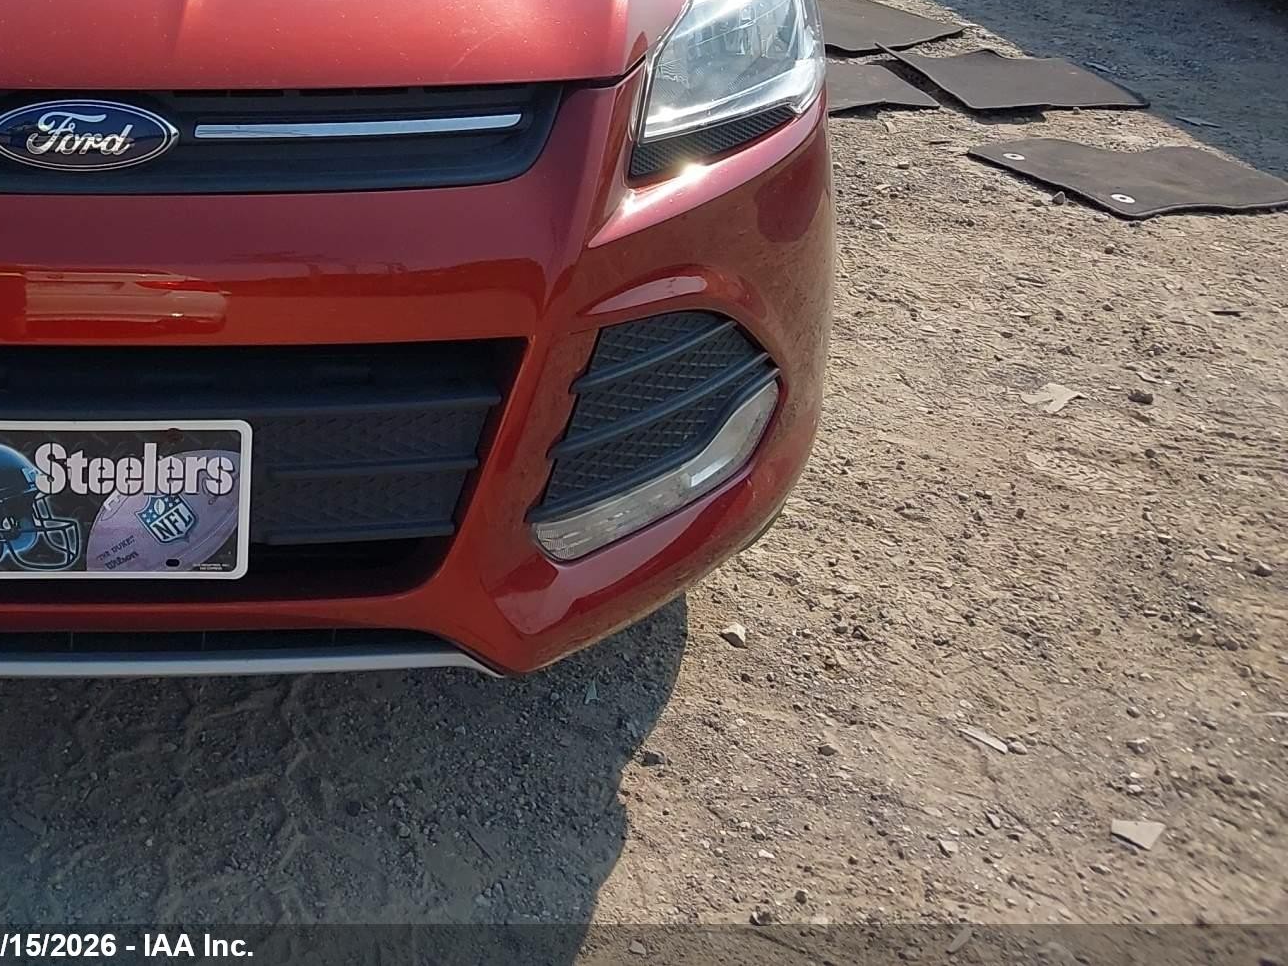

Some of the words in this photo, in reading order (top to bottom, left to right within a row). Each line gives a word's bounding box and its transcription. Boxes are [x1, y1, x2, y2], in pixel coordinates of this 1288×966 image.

[26, 111, 133, 155] Ford
[34, 442, 234, 495] Steelers
[151, 507, 193, 540] NFL
